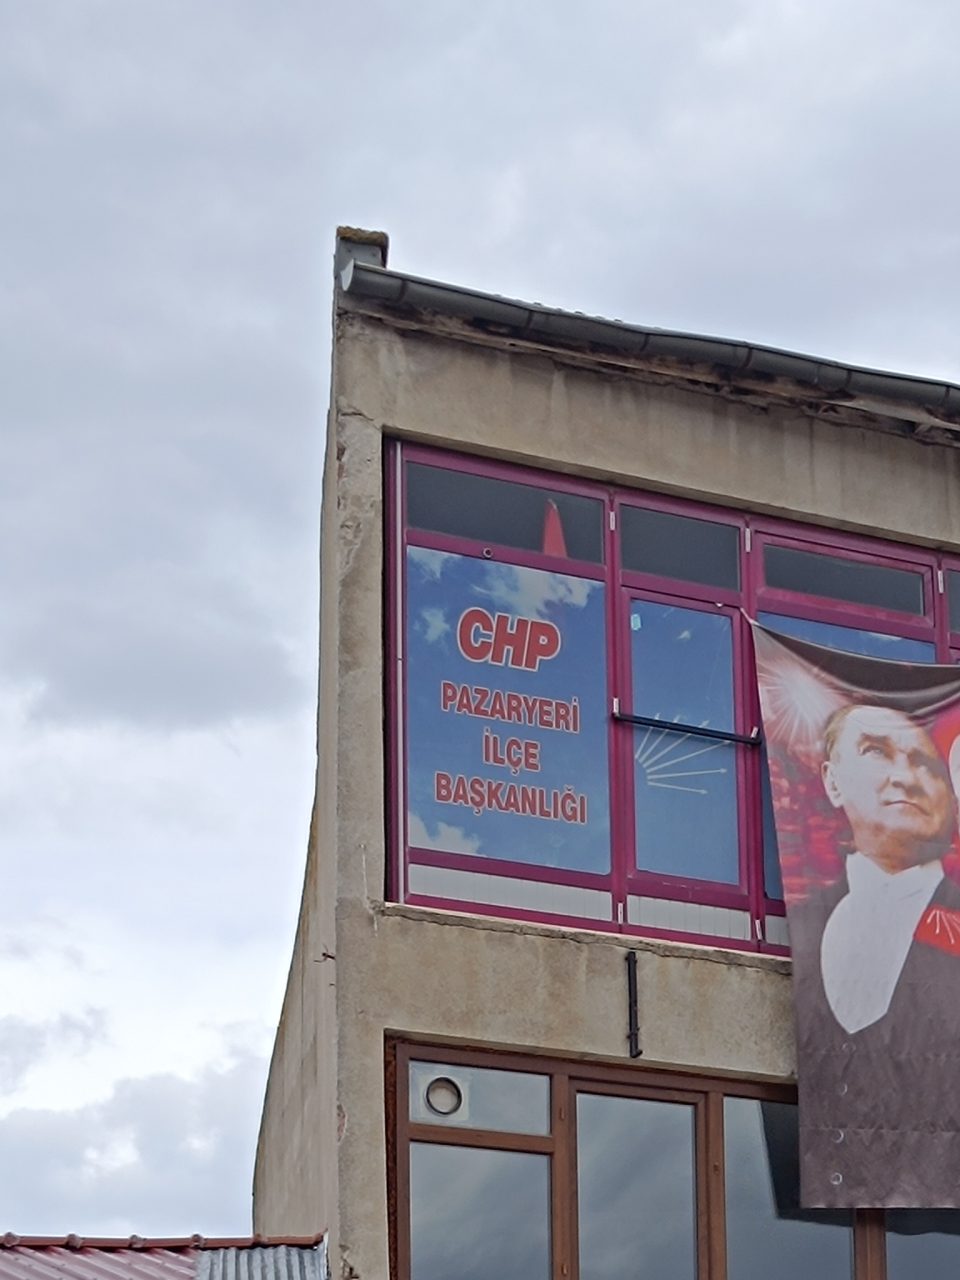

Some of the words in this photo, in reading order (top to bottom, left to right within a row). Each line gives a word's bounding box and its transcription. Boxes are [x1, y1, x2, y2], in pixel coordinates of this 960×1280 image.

[457, 607, 560, 672] CHP
[441, 680, 580, 733] PAZARYERİ
[483, 726, 540, 775] İLÇE
[435, 772, 587, 824] BAŞKANLIĞI
